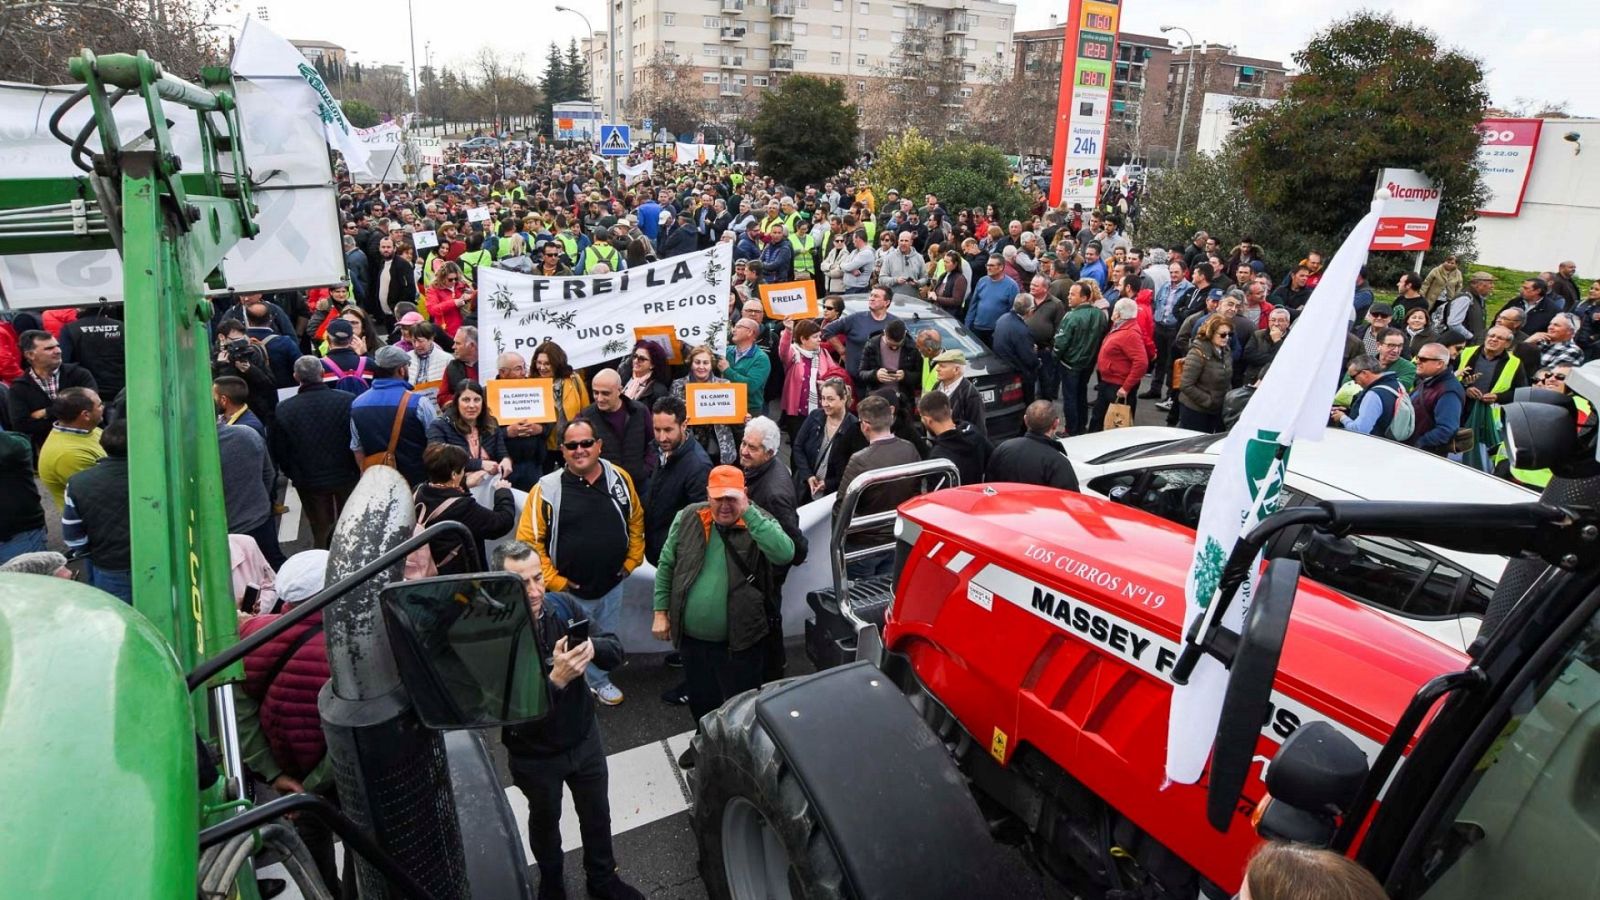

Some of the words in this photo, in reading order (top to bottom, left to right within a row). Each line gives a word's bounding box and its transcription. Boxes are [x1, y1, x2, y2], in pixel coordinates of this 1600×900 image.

[1073, 137, 1096, 155] 24h
[643, 294, 717, 314] PRECIOS
[772, 293, 803, 303] FREILA
[80, 325, 119, 333] FENDT
[576, 323, 626, 340] UNOS
[1024, 544, 1055, 564] LOS
[1055, 555, 1121, 591] CURROS
[1031, 586, 1152, 660] MASSEY
